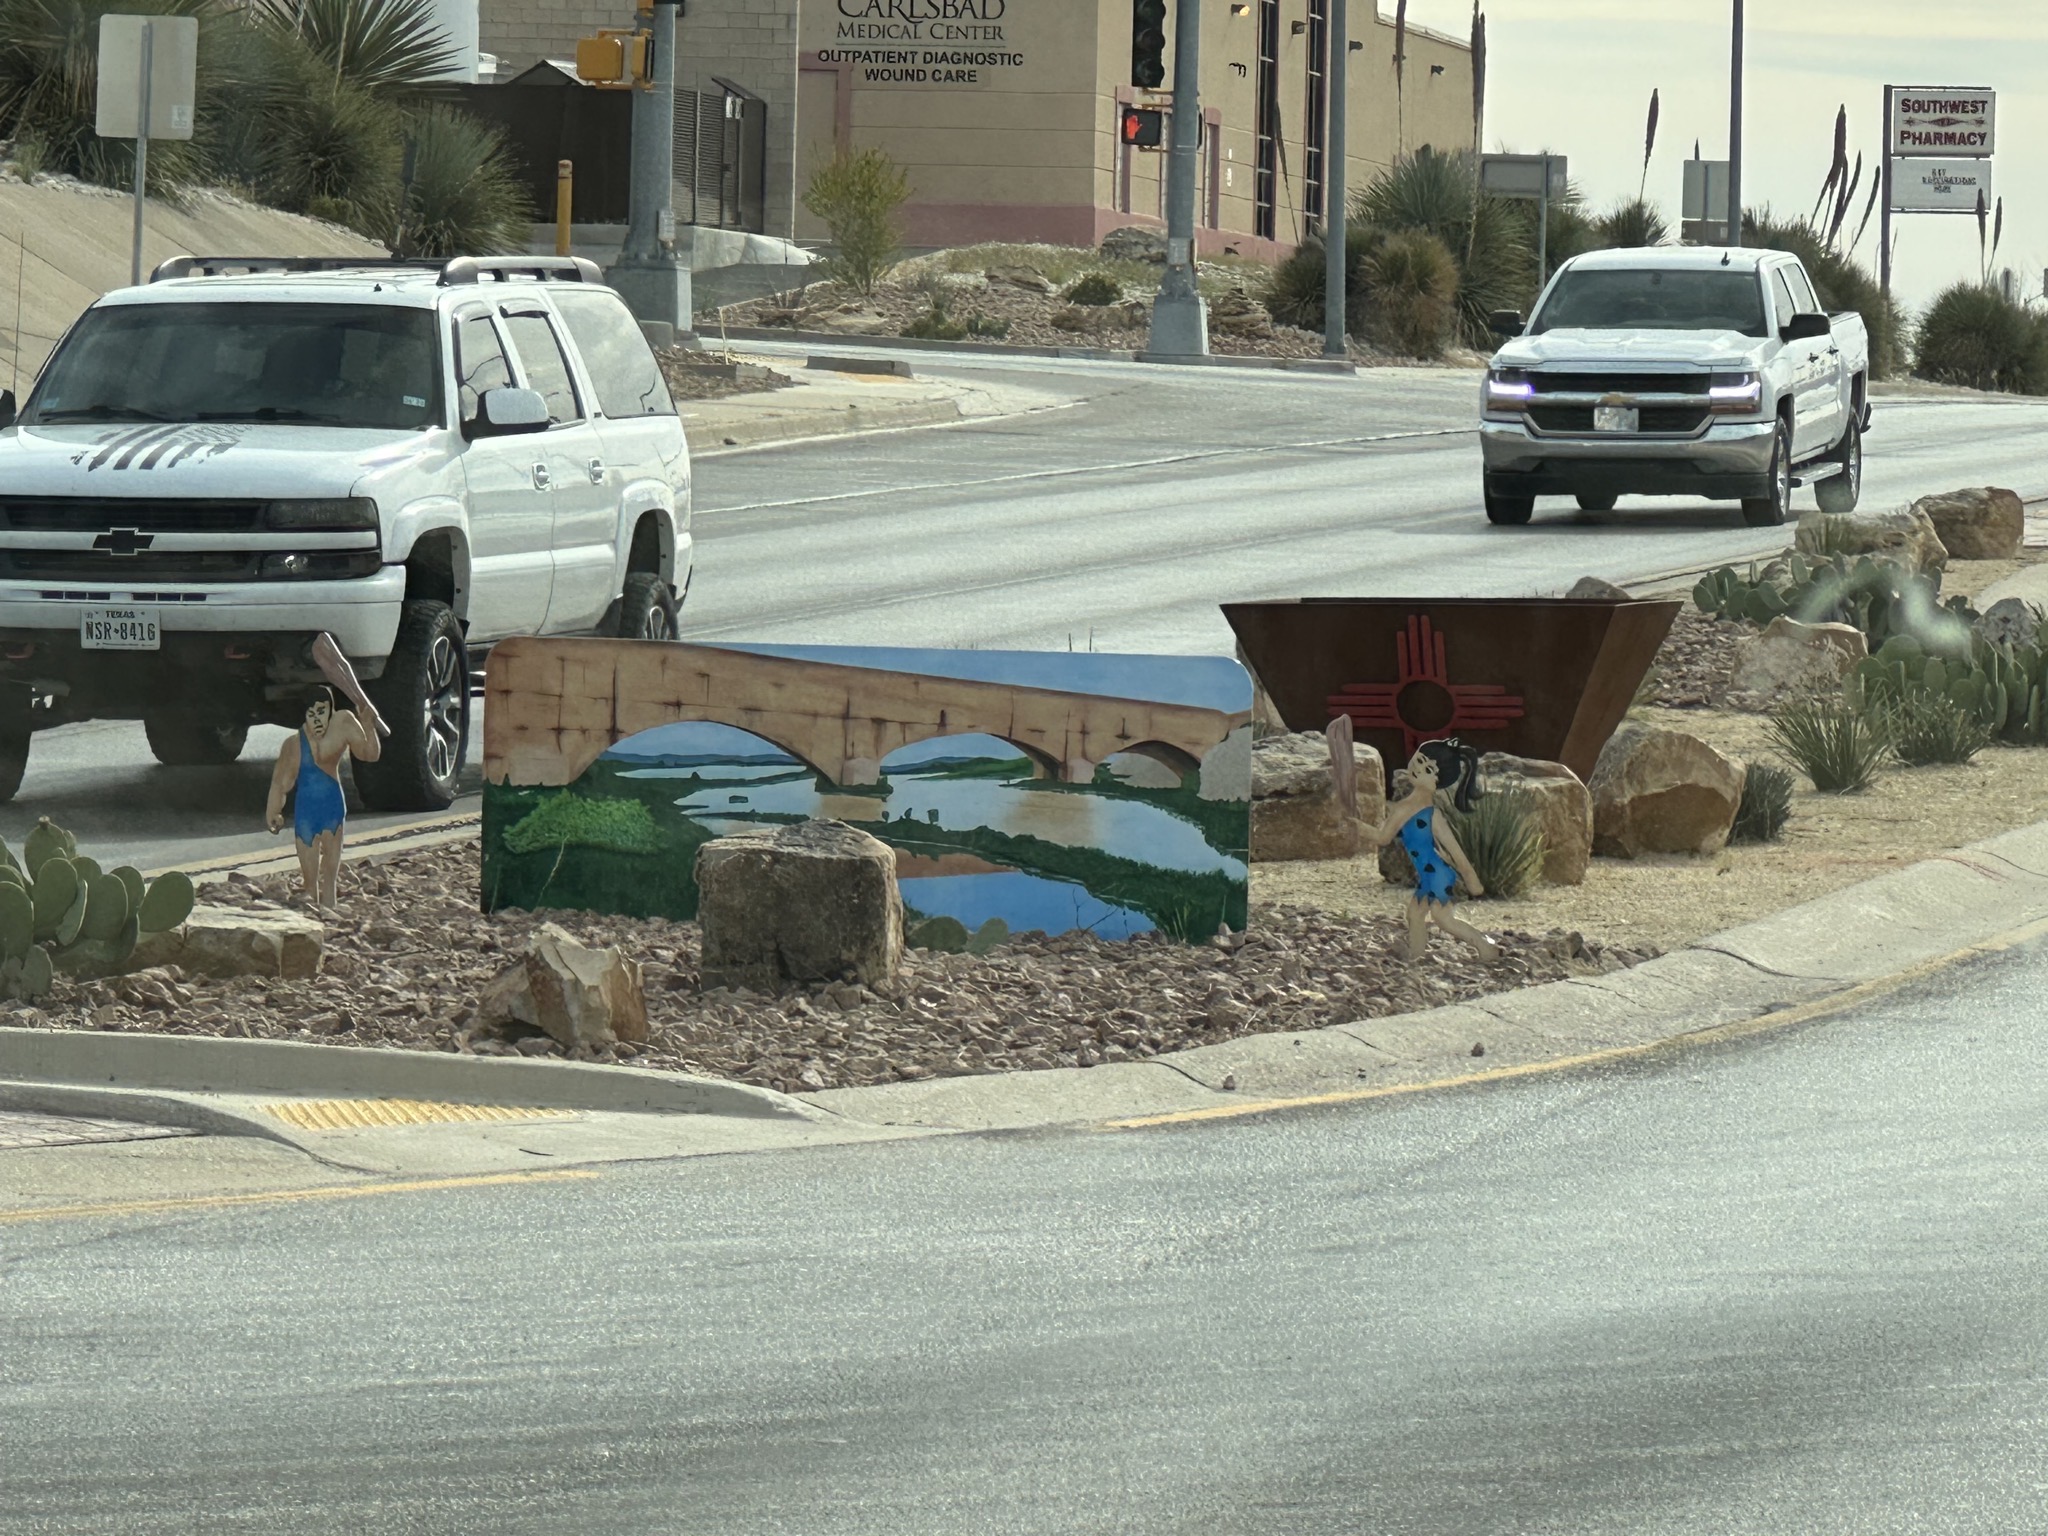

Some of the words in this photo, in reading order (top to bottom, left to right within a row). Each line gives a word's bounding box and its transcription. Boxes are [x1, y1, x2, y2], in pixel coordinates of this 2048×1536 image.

[837, 22, 922, 39] MEDICAL
[929, 23, 1005, 41] CENTER
[818, 50, 918, 64] OUTPATIENT
[923, 51, 1024, 66] DIAGNOSTIC
[865, 68, 927, 82] WOUND
[931, 69, 977, 82] CARE
[1901, 98, 1988, 114] SOUTHWEST
[1900, 130, 1987, 146] PHARMACY
[106, 610, 135, 618] TEXAS
